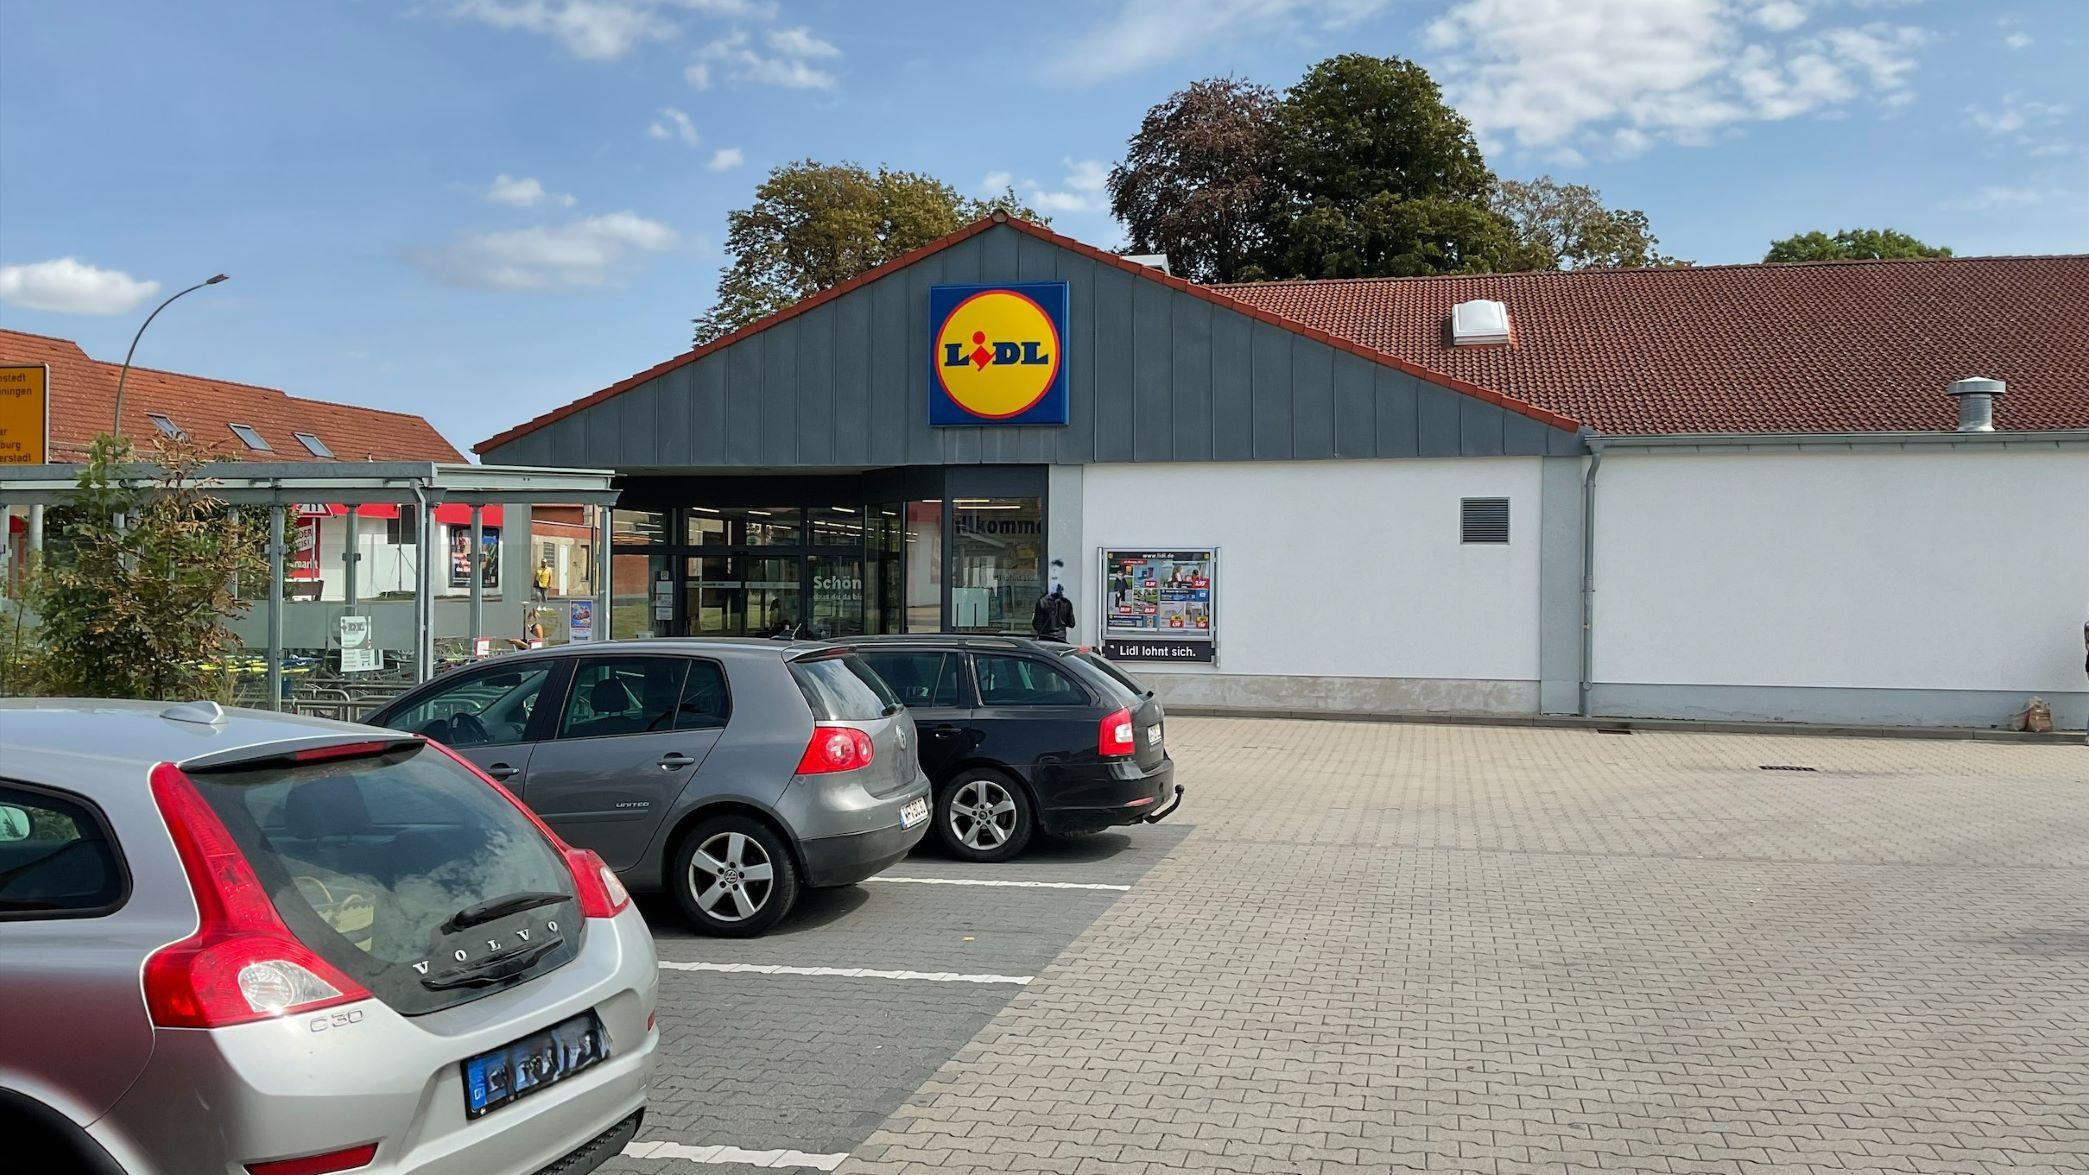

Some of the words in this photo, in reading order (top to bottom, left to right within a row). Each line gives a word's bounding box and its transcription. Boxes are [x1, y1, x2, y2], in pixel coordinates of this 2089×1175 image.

[944, 331, 1048, 371] LIDL
[0, 387, 32, 397] ningen
[813, 575, 862, 590] Schön
[1119, 645, 1139, 656] Lidl
[1142, 645, 1169, 656] lohnt
[1171, 646, 1197, 657] sich.
[413, 920, 558, 975] VOLVO
[310, 1009, 364, 1033] C30
